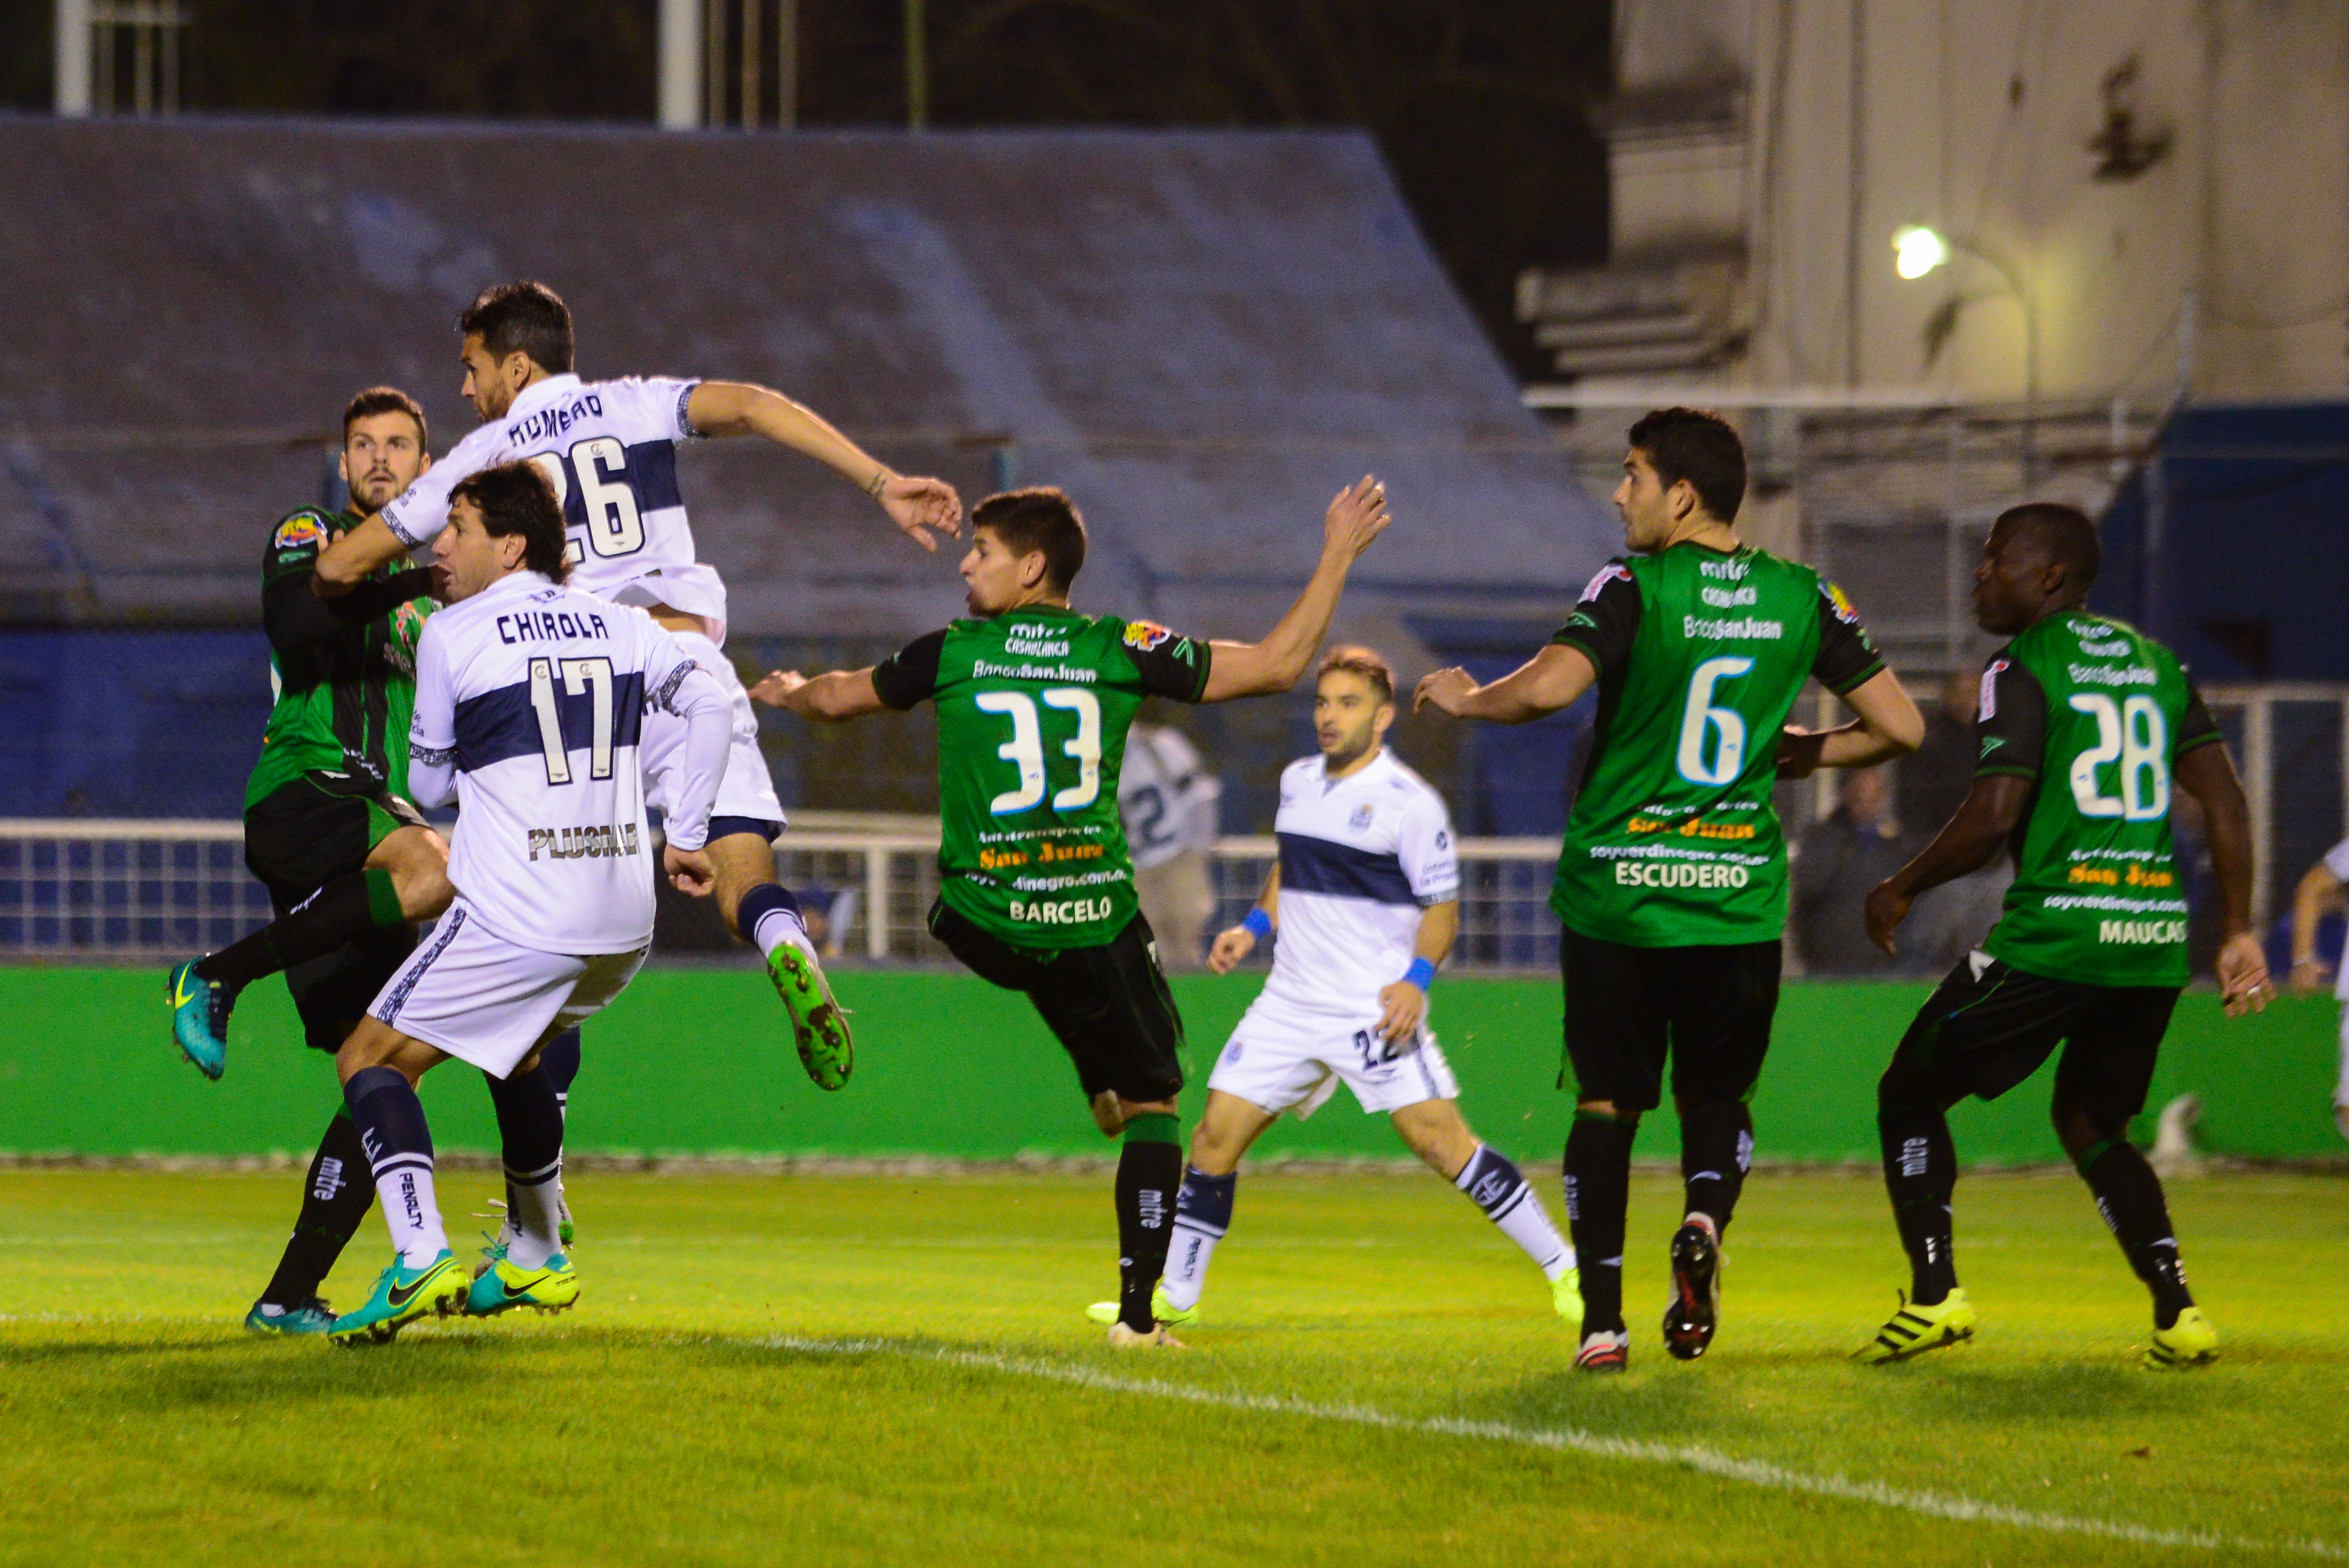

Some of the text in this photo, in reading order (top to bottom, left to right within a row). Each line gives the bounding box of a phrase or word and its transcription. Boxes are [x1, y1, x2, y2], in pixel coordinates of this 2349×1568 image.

[497, 612, 609, 644] CHIROLA
[527, 657, 615, 787] 17
[1675, 655, 1756, 788] 6
[974, 688, 1102, 817] 33
[2068, 693, 2170, 822] 28
[1615, 861, 1749, 888] ESCUDERO
[1009, 895, 1113, 925] BARCELO
[313, 1156, 347, 1201] mitre
[1895, 1136, 1928, 1178] mitre
[398, 1172, 425, 1231] PENALTY
[1138, 1189, 1168, 1229] mitre
